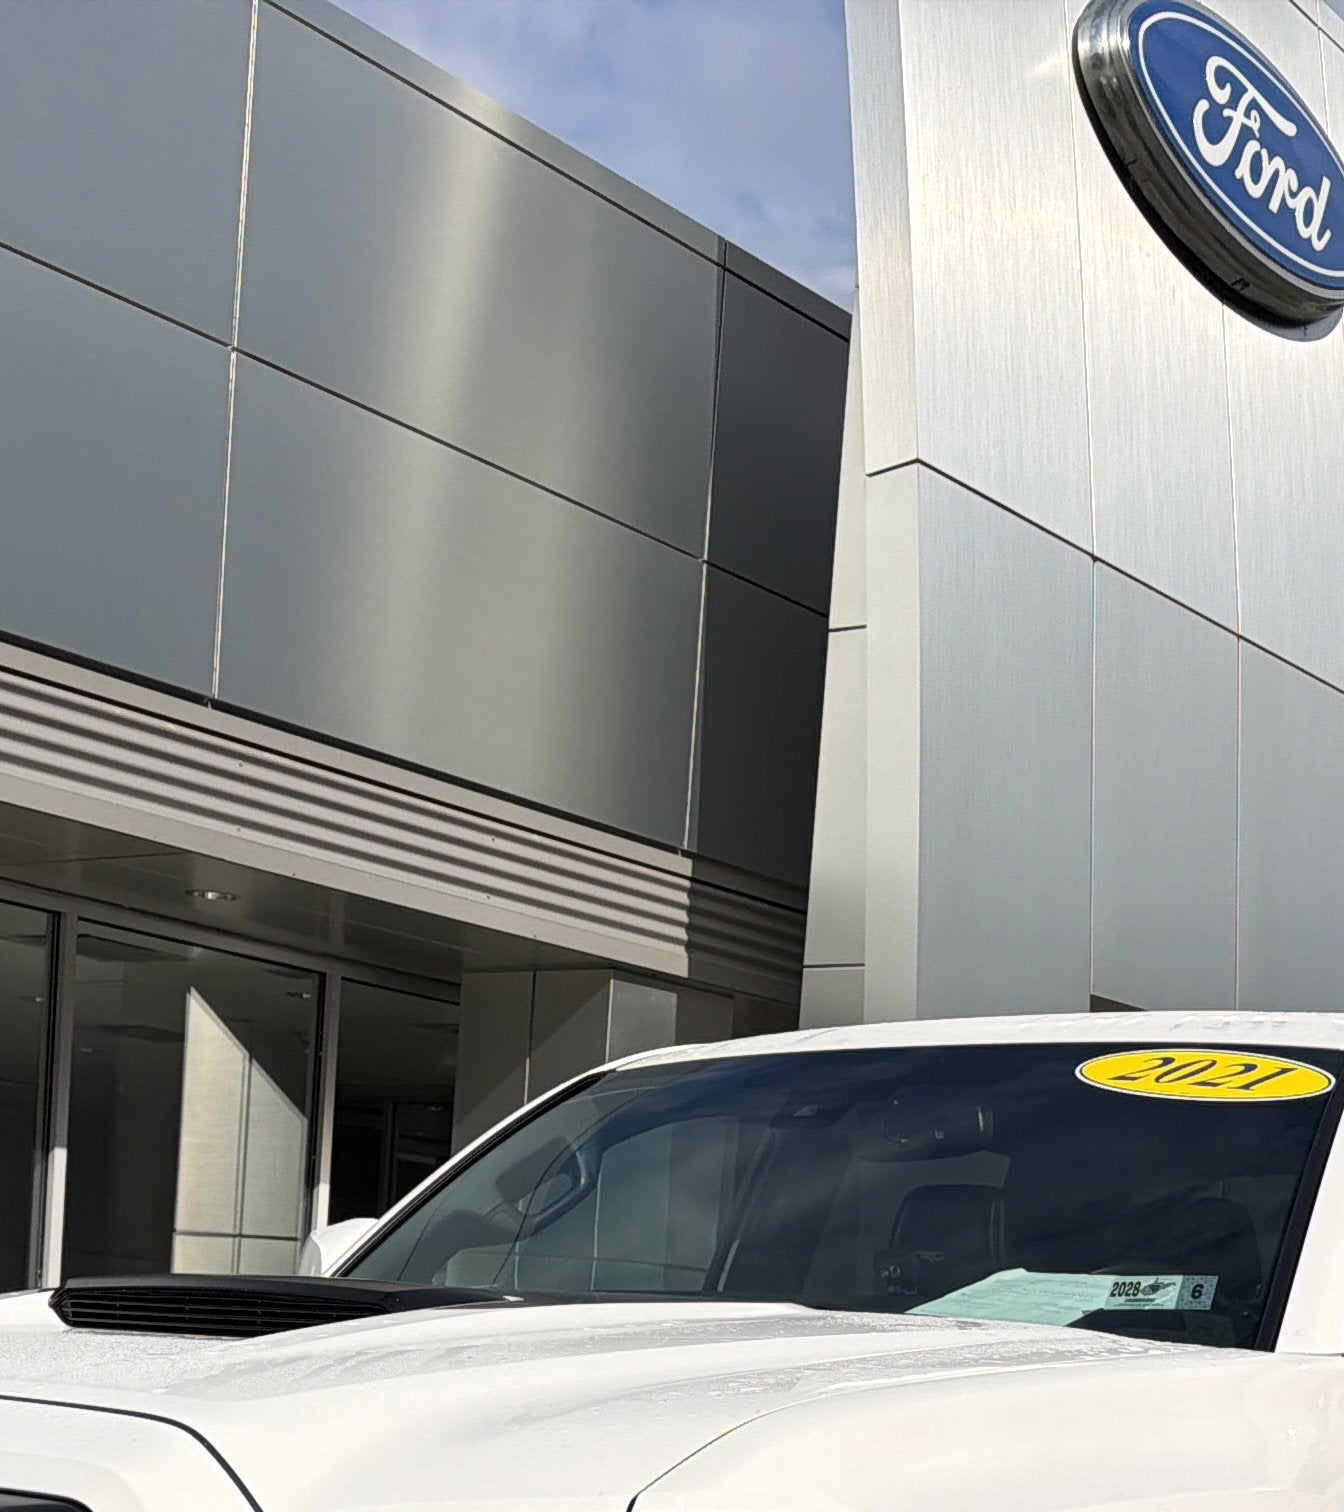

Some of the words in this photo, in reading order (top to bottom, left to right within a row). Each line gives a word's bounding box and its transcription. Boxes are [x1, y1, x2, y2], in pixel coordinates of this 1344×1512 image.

[1193, 56, 1331, 251] Ford
[1108, 1057, 1298, 1091] 2021
[1110, 1281, 1142, 1298] 2028
[1191, 1283, 1205, 1300] 6
